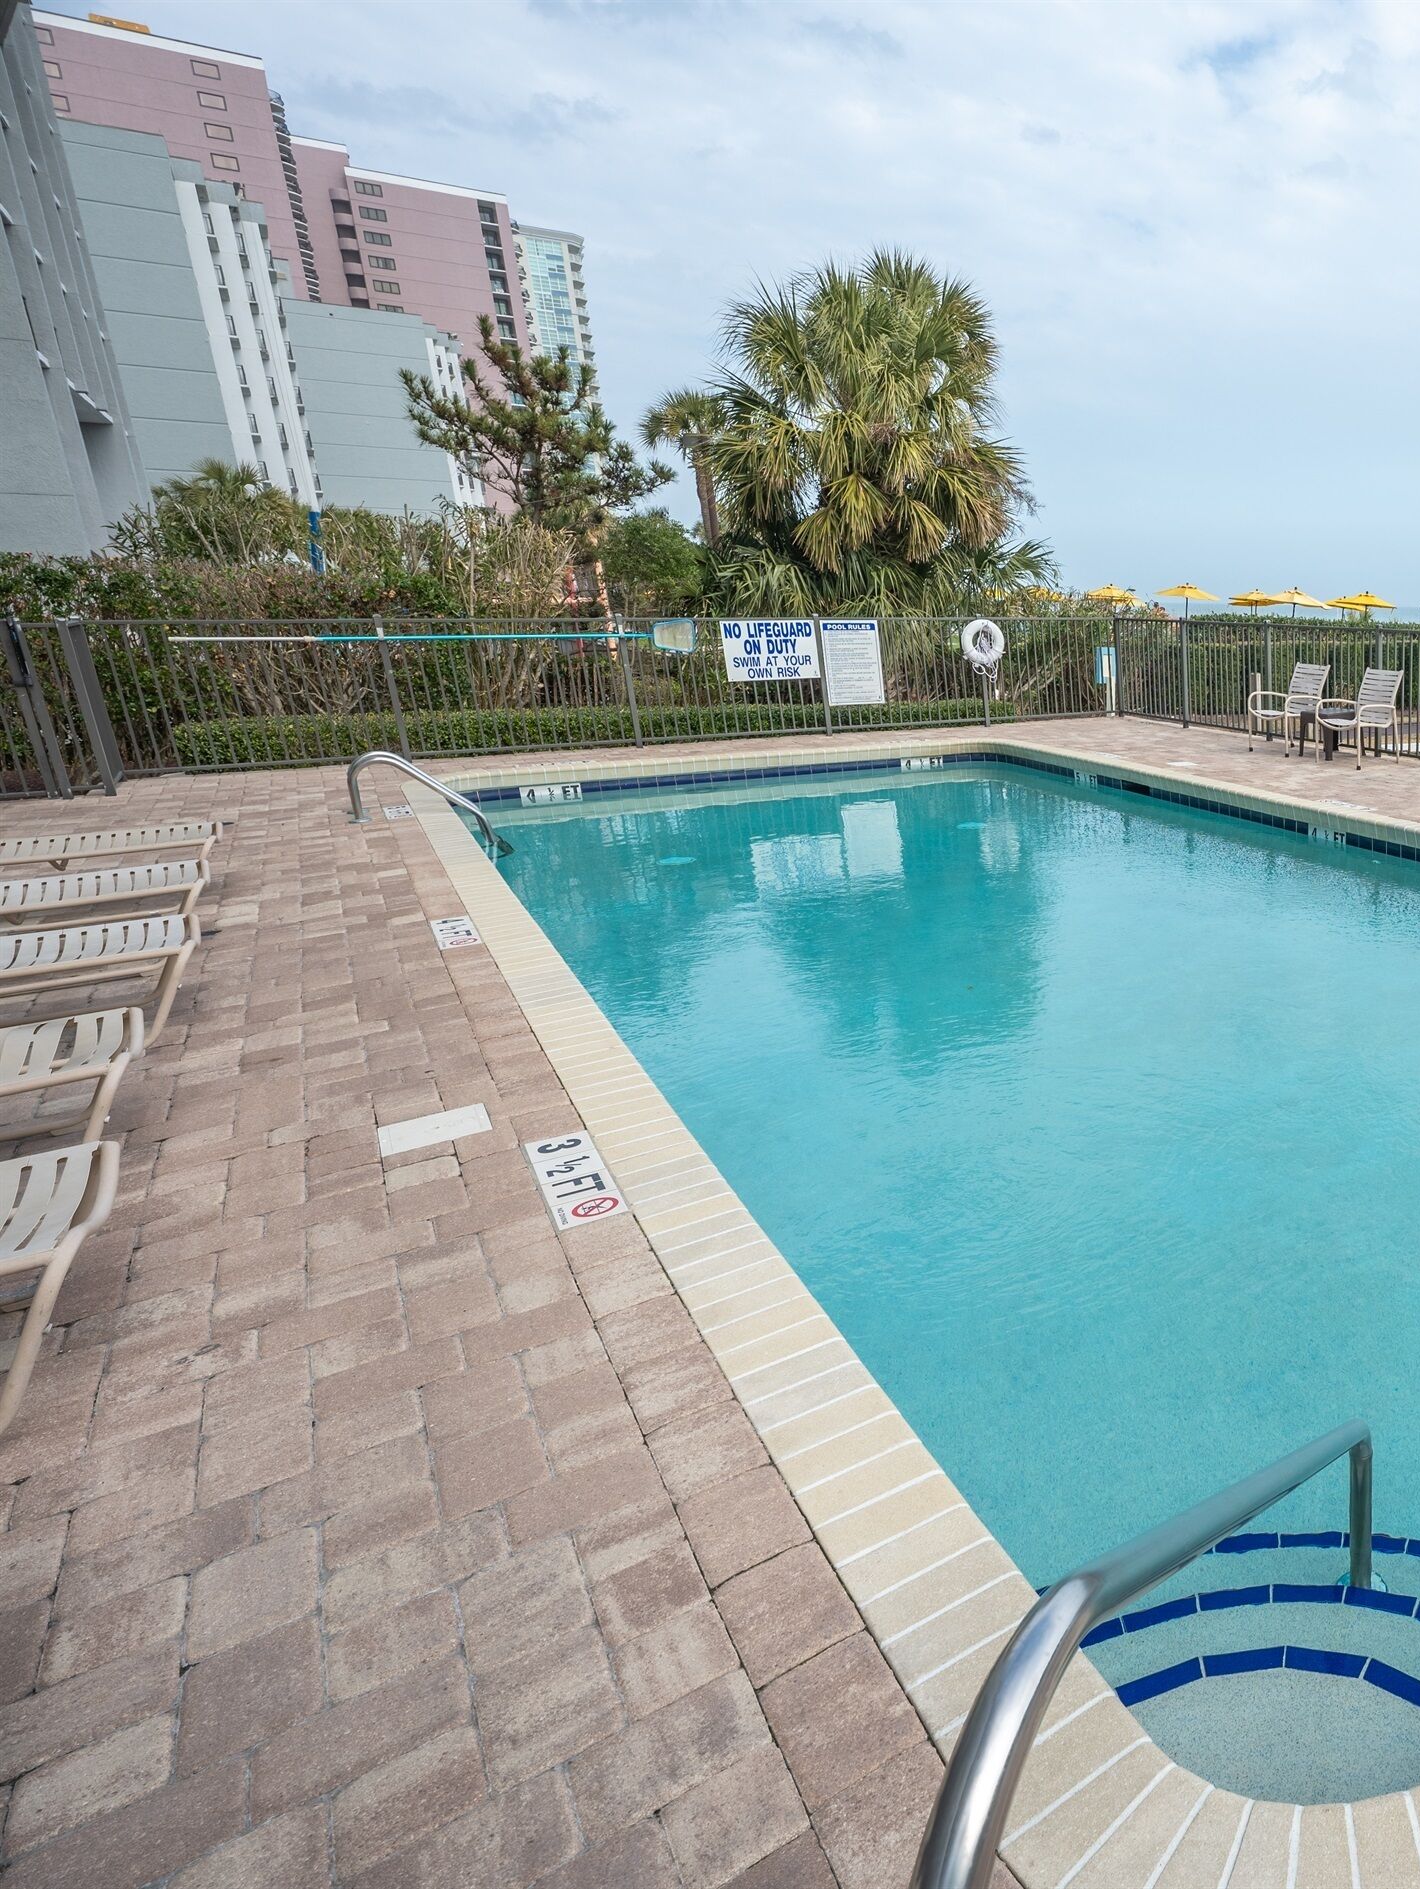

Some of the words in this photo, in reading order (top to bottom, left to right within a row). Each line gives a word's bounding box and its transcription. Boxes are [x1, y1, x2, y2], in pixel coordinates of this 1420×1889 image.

[723, 622, 741, 639] NO
[747, 622, 812, 639] LIFEGUARD
[744, 639, 761, 655] ON
[767, 638, 797, 655] DUTY
[733, 656, 761, 668] SWIM
[766, 656, 779, 667] AT
[784, 655, 812, 666] YOUR
[748, 668, 772, 679] OWN
[778, 666, 801, 678] RISK
[1333, 831, 1345, 843] FT
[441, 929, 472, 939] FT
[537, 1138, 582, 1154] 3
[552, 1172, 606, 1198] FT
